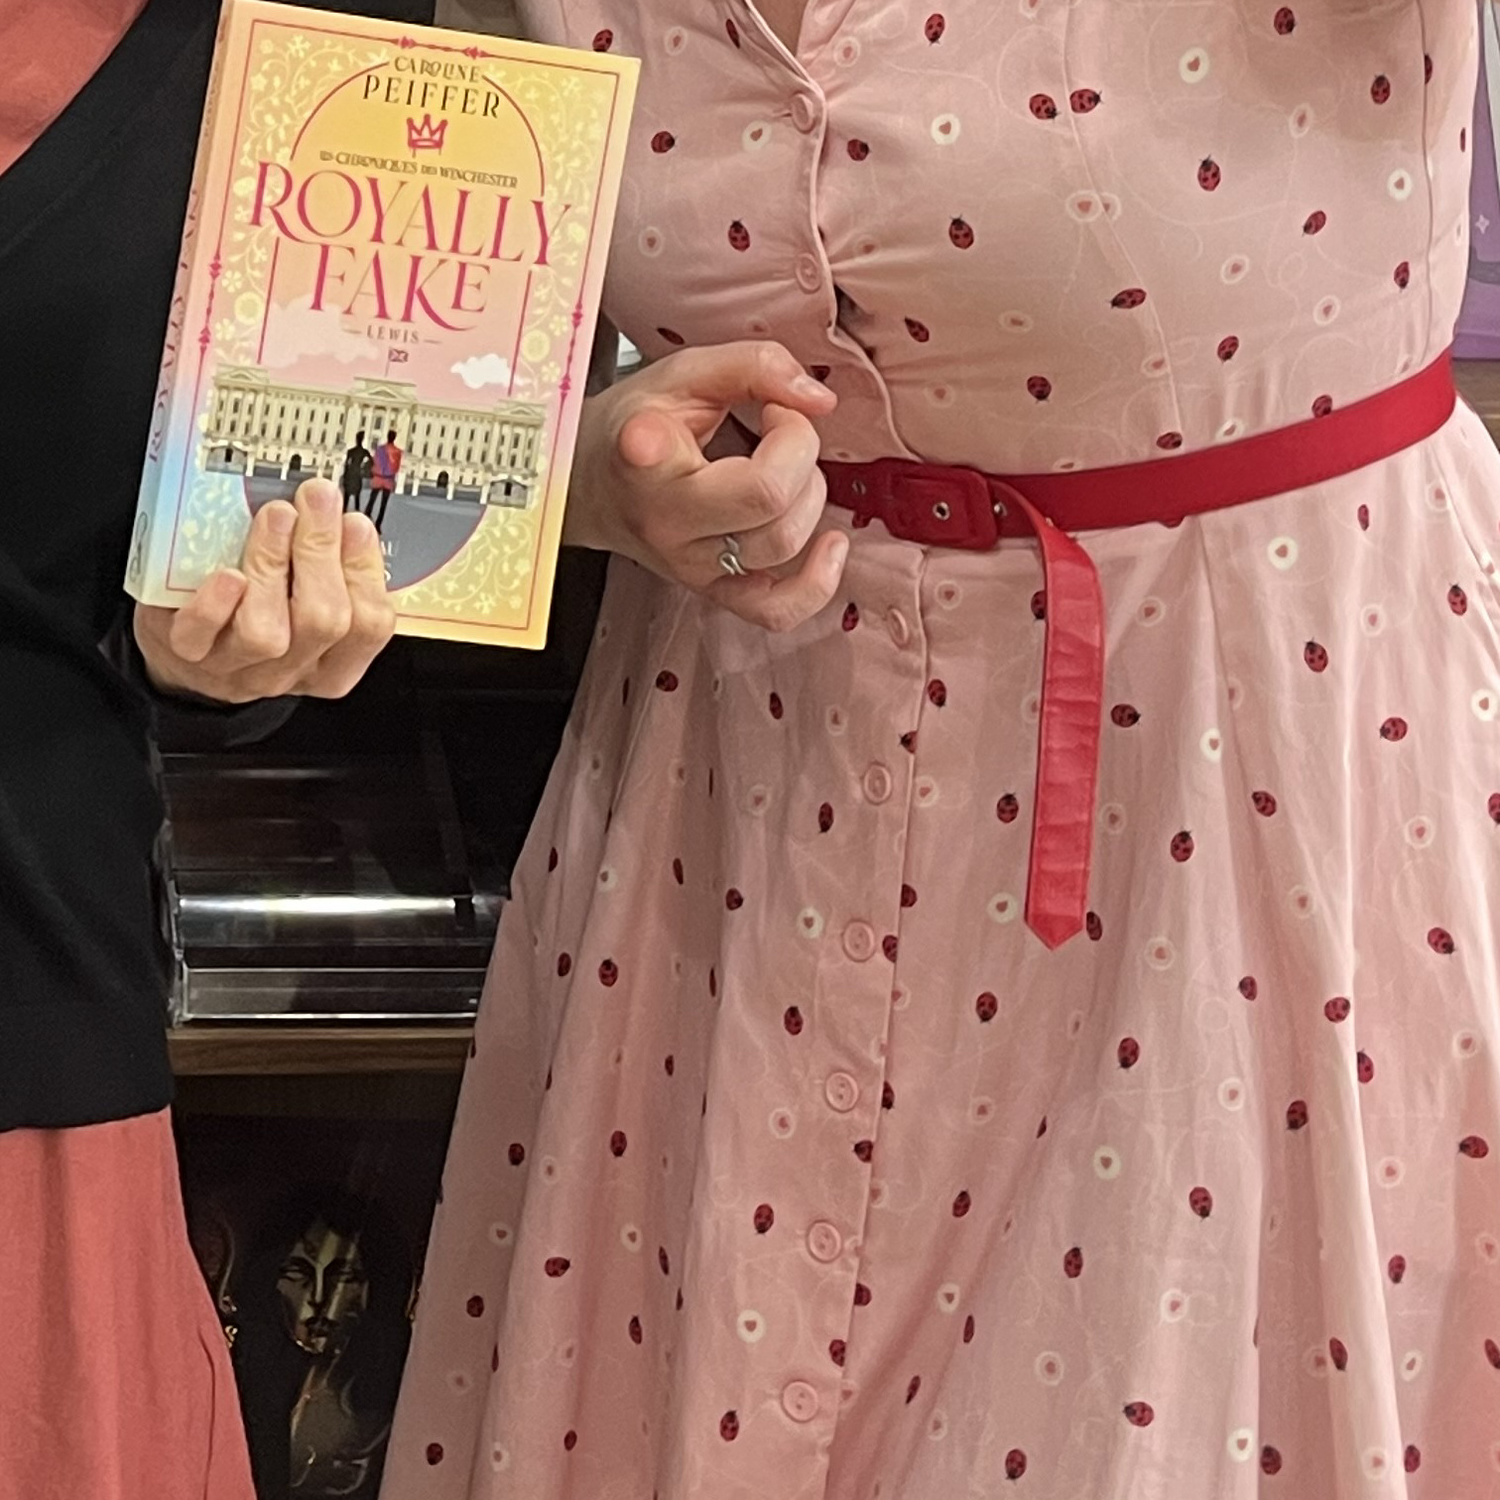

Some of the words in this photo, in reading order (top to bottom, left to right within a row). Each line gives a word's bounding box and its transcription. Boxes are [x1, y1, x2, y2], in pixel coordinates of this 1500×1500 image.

[394, 55, 481, 83] CAROLINE
[363, 74, 500, 118] PEIFFER
[335, 151, 418, 175] CHRONIQUES
[440, 166, 518, 189] WINCHESTER
[250, 160, 571, 267] ROYALLY
[309, 243, 492, 333] FAKE
[366, 324, 419, 346] LEWIS
